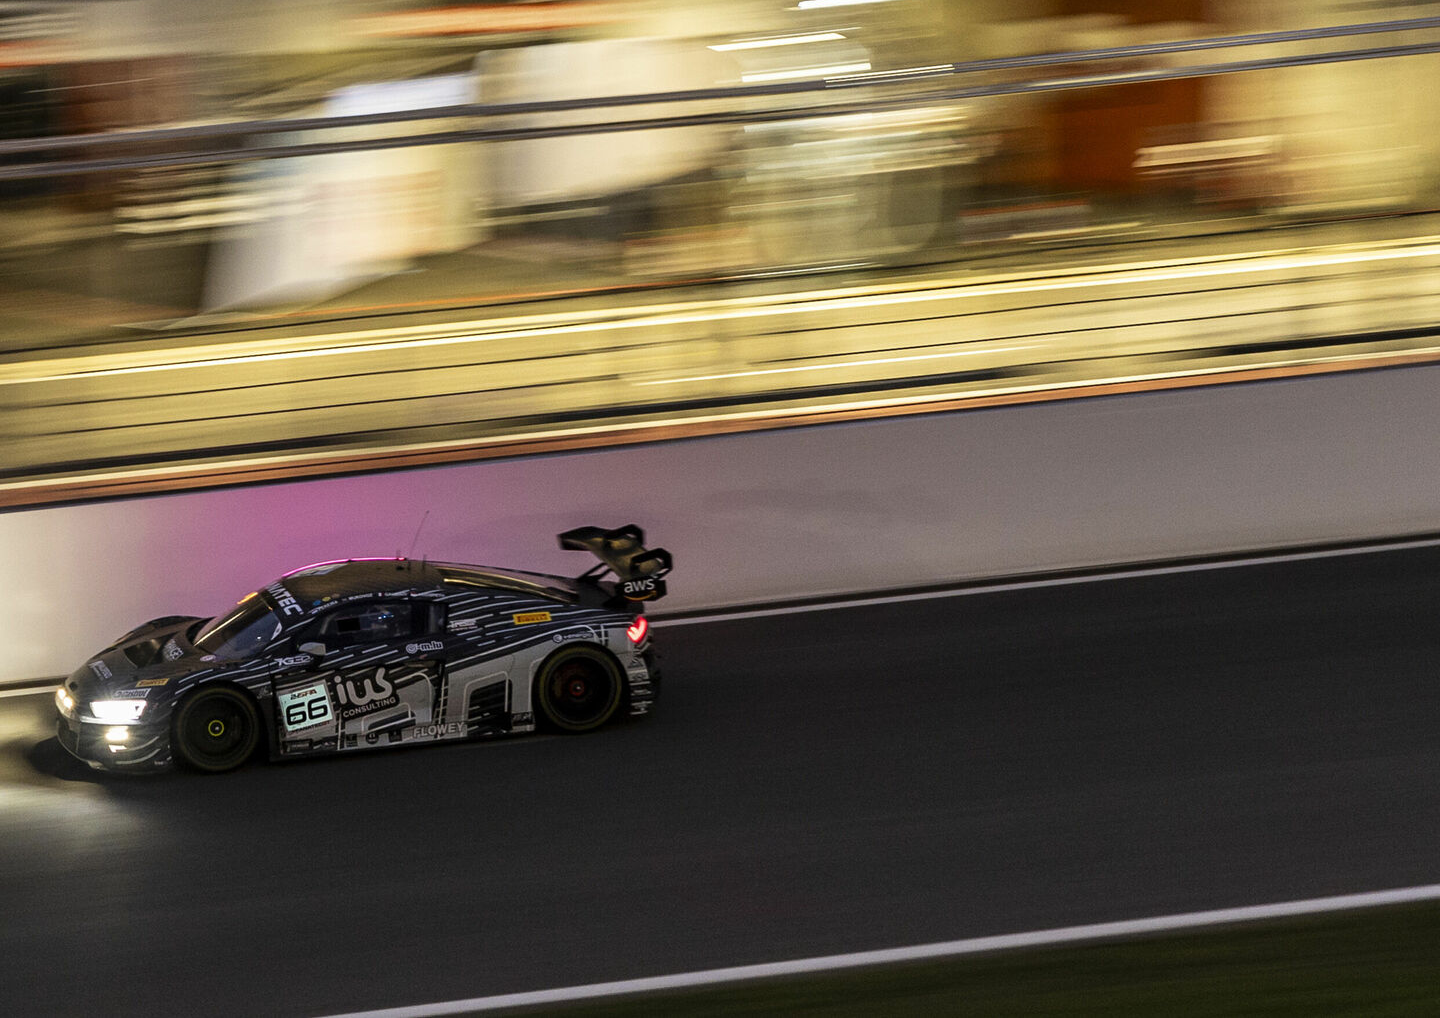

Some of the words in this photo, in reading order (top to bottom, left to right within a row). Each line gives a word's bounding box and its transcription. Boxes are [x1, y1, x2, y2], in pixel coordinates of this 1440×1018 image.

[624, 578, 655, 593] aws
[333, 667, 393, 705] ius
[285, 695, 328, 726] 66
[342, 696, 397, 718] CONSULTING
[413, 722, 464, 737] FLOWEY
